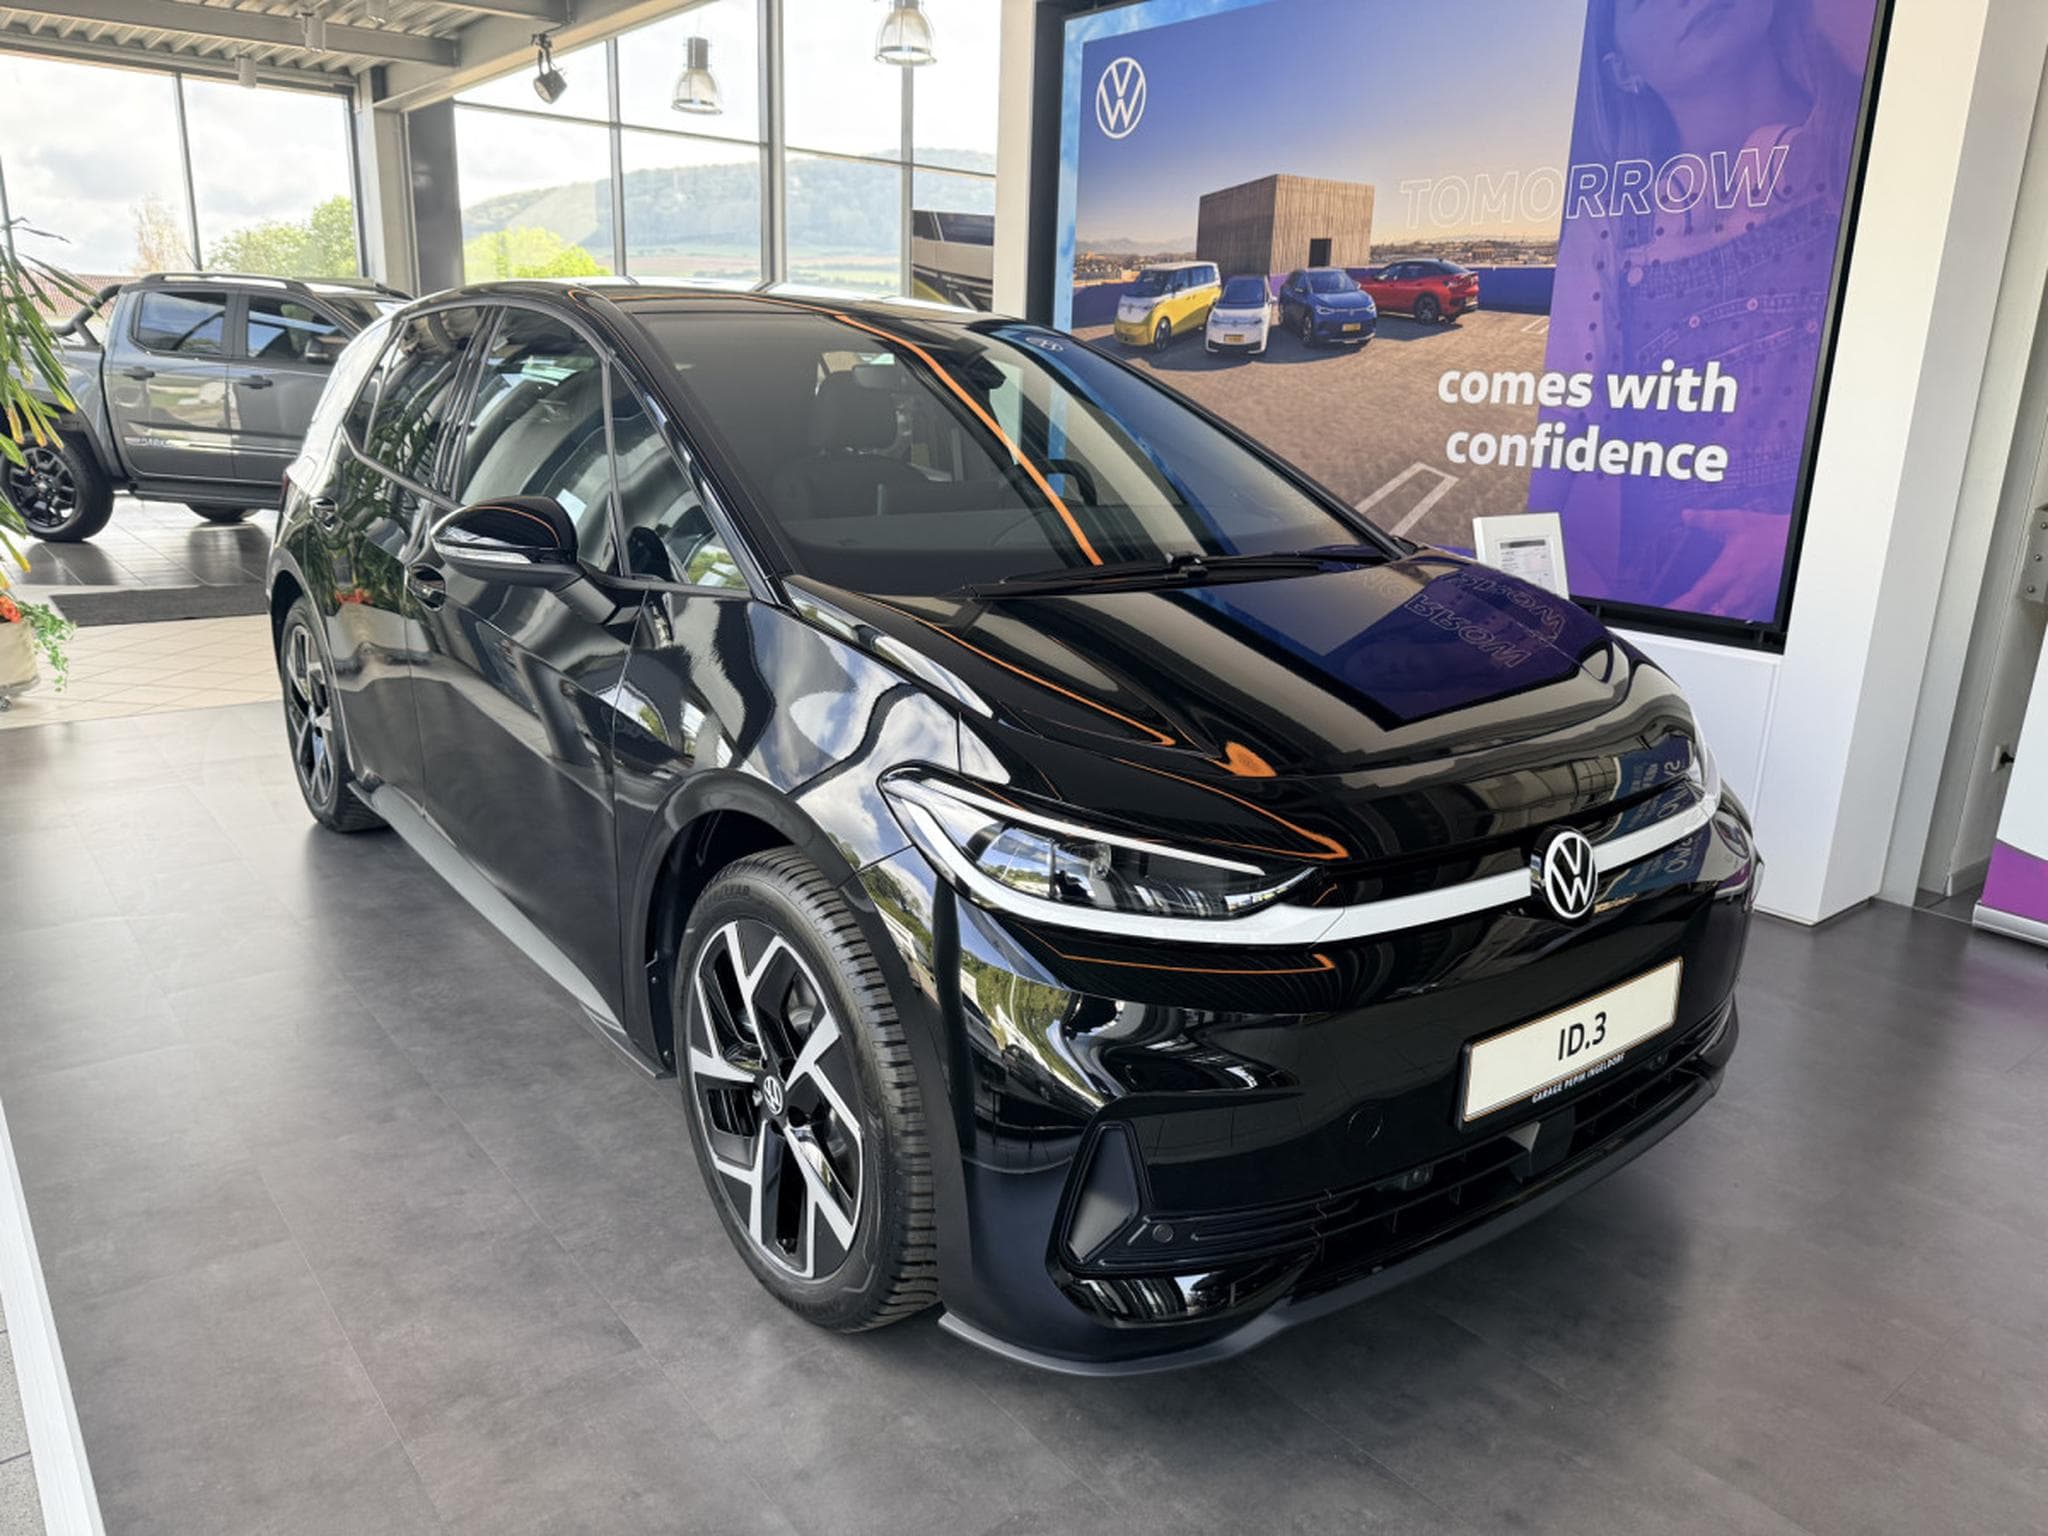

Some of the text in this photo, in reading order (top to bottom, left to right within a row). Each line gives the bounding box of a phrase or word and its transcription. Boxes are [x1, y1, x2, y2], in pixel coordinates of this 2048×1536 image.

[1096, 57, 1146, 138] VW
[1400, 145, 1790, 230] TOMORROW
[1438, 359, 1738, 413] comes with
[1446, 421, 1729, 482] confidence
[1544, 831, 1599, 919] VW
[1557, 1011, 1608, 1061] ID.3
[1532, 1085, 1563, 1103] GARAGE
